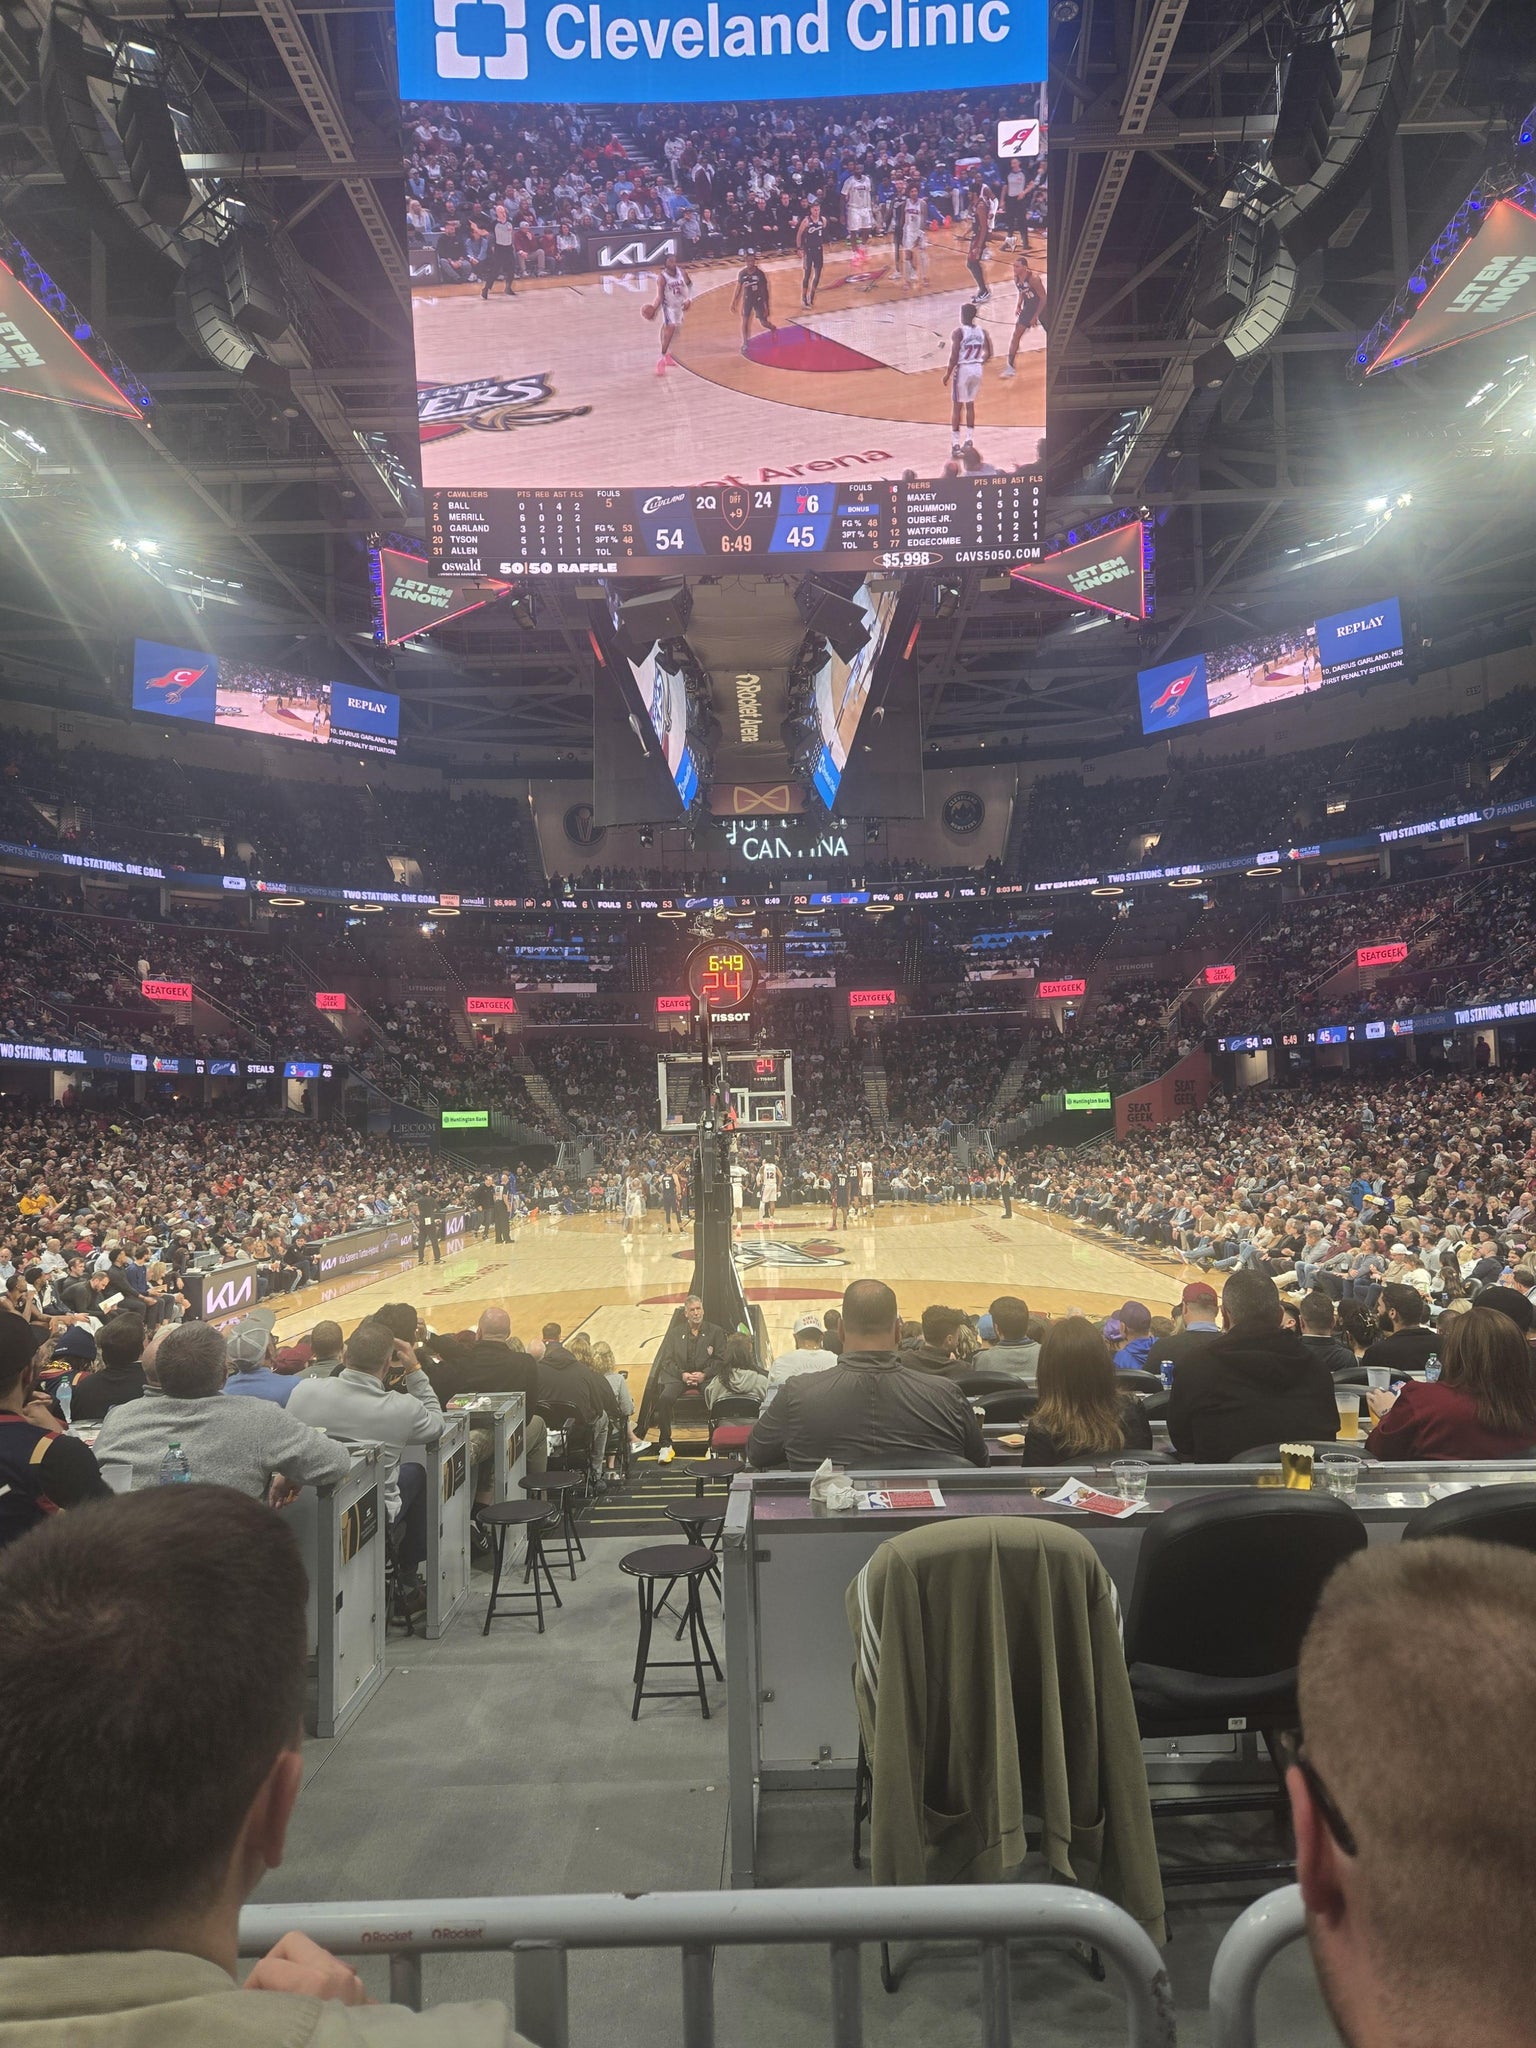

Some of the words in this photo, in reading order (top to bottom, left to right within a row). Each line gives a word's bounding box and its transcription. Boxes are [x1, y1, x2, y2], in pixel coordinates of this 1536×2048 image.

[546, 0, 829, 60] Cleveland
[847, 0, 1010, 51] Clinic
[1444, 282, 1489, 312] LET
[1473, 256, 1518, 281] EM
[10, 342, 46, 367] EM
[759, 450, 893, 482] Arena
[849, 484, 872, 492] FOULS
[907, 482, 930, 490] 76ERS
[696, 496, 716, 510] 2Q
[730, 495, 742, 504] DIFF
[754, 492, 772, 508] 24
[858, 493, 864, 502] 4
[907, 493, 937, 501] MAXEY
[796, 495, 818, 513] 76
[907, 504, 956, 513] DRUMMOND
[449, 513, 484, 521] MERRILL
[730, 508, 742, 518] +9
[907, 516, 936, 524] OUBRE
[939, 515, 952, 523] JR.
[450, 524, 489, 532] GARLAND
[868, 530, 878, 538] 40
[907, 526, 948, 535] WATFORD
[656, 529, 684, 550] 54
[722, 535, 752, 552] 6:49
[786, 526, 815, 548] 45
[908, 537, 961, 546] EDGECOMBE
[882, 552, 929, 568] $5,998
[956, 548, 1041, 562] CAVS5050.COM
[442, 559, 481, 572] oswald
[558, 563, 617, 573] RAFFLE
[1067, 565, 1097, 583] LET
[1099, 556, 1126, 572] EM
[1073, 565, 1135, 592] KNOW.
[395, 577, 428, 591] LET
[428, 585, 453, 598] EM
[390, 588, 449, 608] KNOW.
[1337, 616, 1384, 638] REPLAY
[1332, 662, 1356, 672] DARIUS
[1392, 649, 1403, 657] HIS
[1323, 676, 1340, 685] FIRST
[1341, 669, 1368, 681] PENALTY
[1369, 660, 1404, 674] SITUATION.
[348, 697, 387, 714] REPLAY
[736, 684, 762, 718] Rocket
[339, 729, 359, 738] DARIUS
[740, 718, 763, 742] Arena
[345, 741, 368, 749] PENALTY
[369, 745, 396, 755] SITUATION.
[1497, 799, 1535, 816] FANDUEL
[1380, 831, 1398, 842] TWO
[1399, 822, 1439, 838] STATIONS.
[1440, 818, 1456, 829] ONE
[1457, 812, 1482, 826] GOAL.
[742, 836, 849, 860] CANNA
[63, 854, 82, 865] TWO
[84, 857, 125, 873] STATIONS.
[126, 864, 142, 875] ONE
[143, 866, 166, 878] GOAL.
[1108, 873, 1125, 884] TWO
[1126, 869, 1164, 882] STATIONS.
[1165, 867, 1180, 877] ONE
[1181, 864, 1204, 876] GOAL.
[1035, 882, 1053, 890] LET
[1054, 880, 1067, 889] EM
[343, 890, 361, 900] TWO
[362, 890, 400, 902] STATIONS.
[402, 894, 416, 903] ONE
[418, 895, 439, 904] GOAL.
[794, 896, 807, 904] 2Q
[820, 895, 832, 903] 45
[915, 891, 938, 900] FOULS
[713, 899, 723, 907] 54
[1361, 947, 1404, 962] SEATGEEK
[709, 955, 743, 971] 6:49
[145, 984, 188, 997] SEATGEEK
[702, 972, 741, 1001] 24
[1042, 984, 1082, 993] SEATGEEK
[470, 1000, 510, 1010] SEATGEEK
[711, 1013, 750, 1022] TISSOT
[1454, 1010, 1470, 1024] TWO
[1470, 1005, 1504, 1022] STATIONS.
[1504, 1002, 1519, 1017] ONE
[1246, 1037, 1258, 1048] 54
[1283, 1035, 1298, 1045] 6:49
[1320, 1030, 1330, 1042] 45
[15, 1045, 52, 1061] STATIONS.
[53, 1050, 67, 1062] ONE
[68, 1051, 87, 1063] GOAL.
[248, 1065, 274, 1073] STEALS
[756, 1059, 774, 1072] 24
[1128, 1103, 1152, 1112] SEAT
[1128, 1112, 1153, 1122] GEEK
[393, 1123, 436, 1132] LECOM
[373, 1931, 413, 1942] Rocket
[443, 1929, 483, 1939] Rocket
